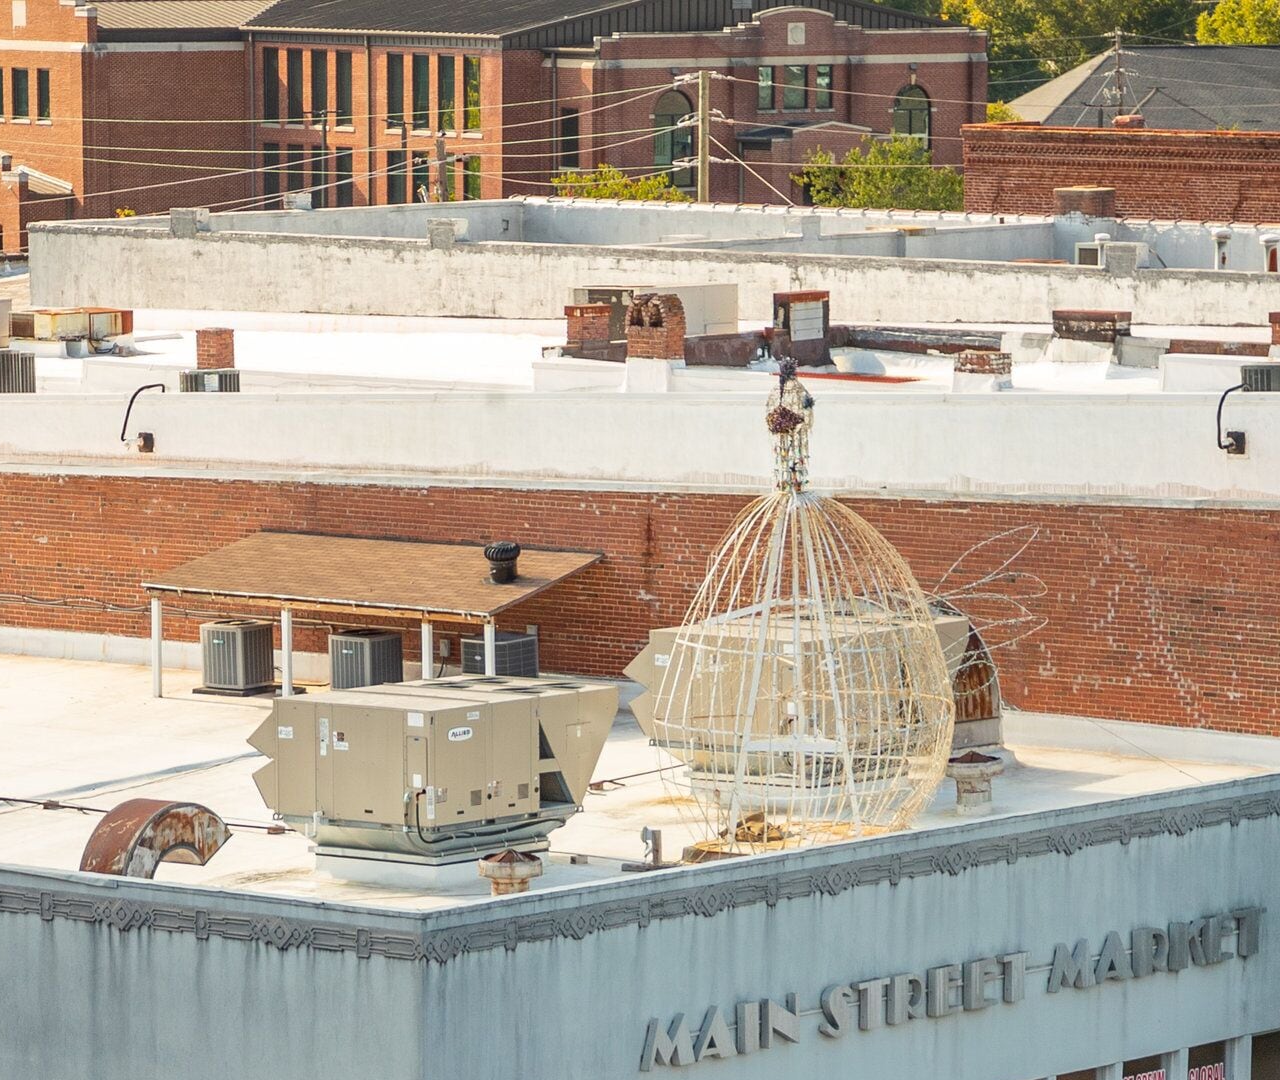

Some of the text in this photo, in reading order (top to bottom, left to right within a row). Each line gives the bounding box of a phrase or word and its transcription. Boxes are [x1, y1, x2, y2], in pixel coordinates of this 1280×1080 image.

[640, 906, 1268, 1072] MAIN STREET MARKET
